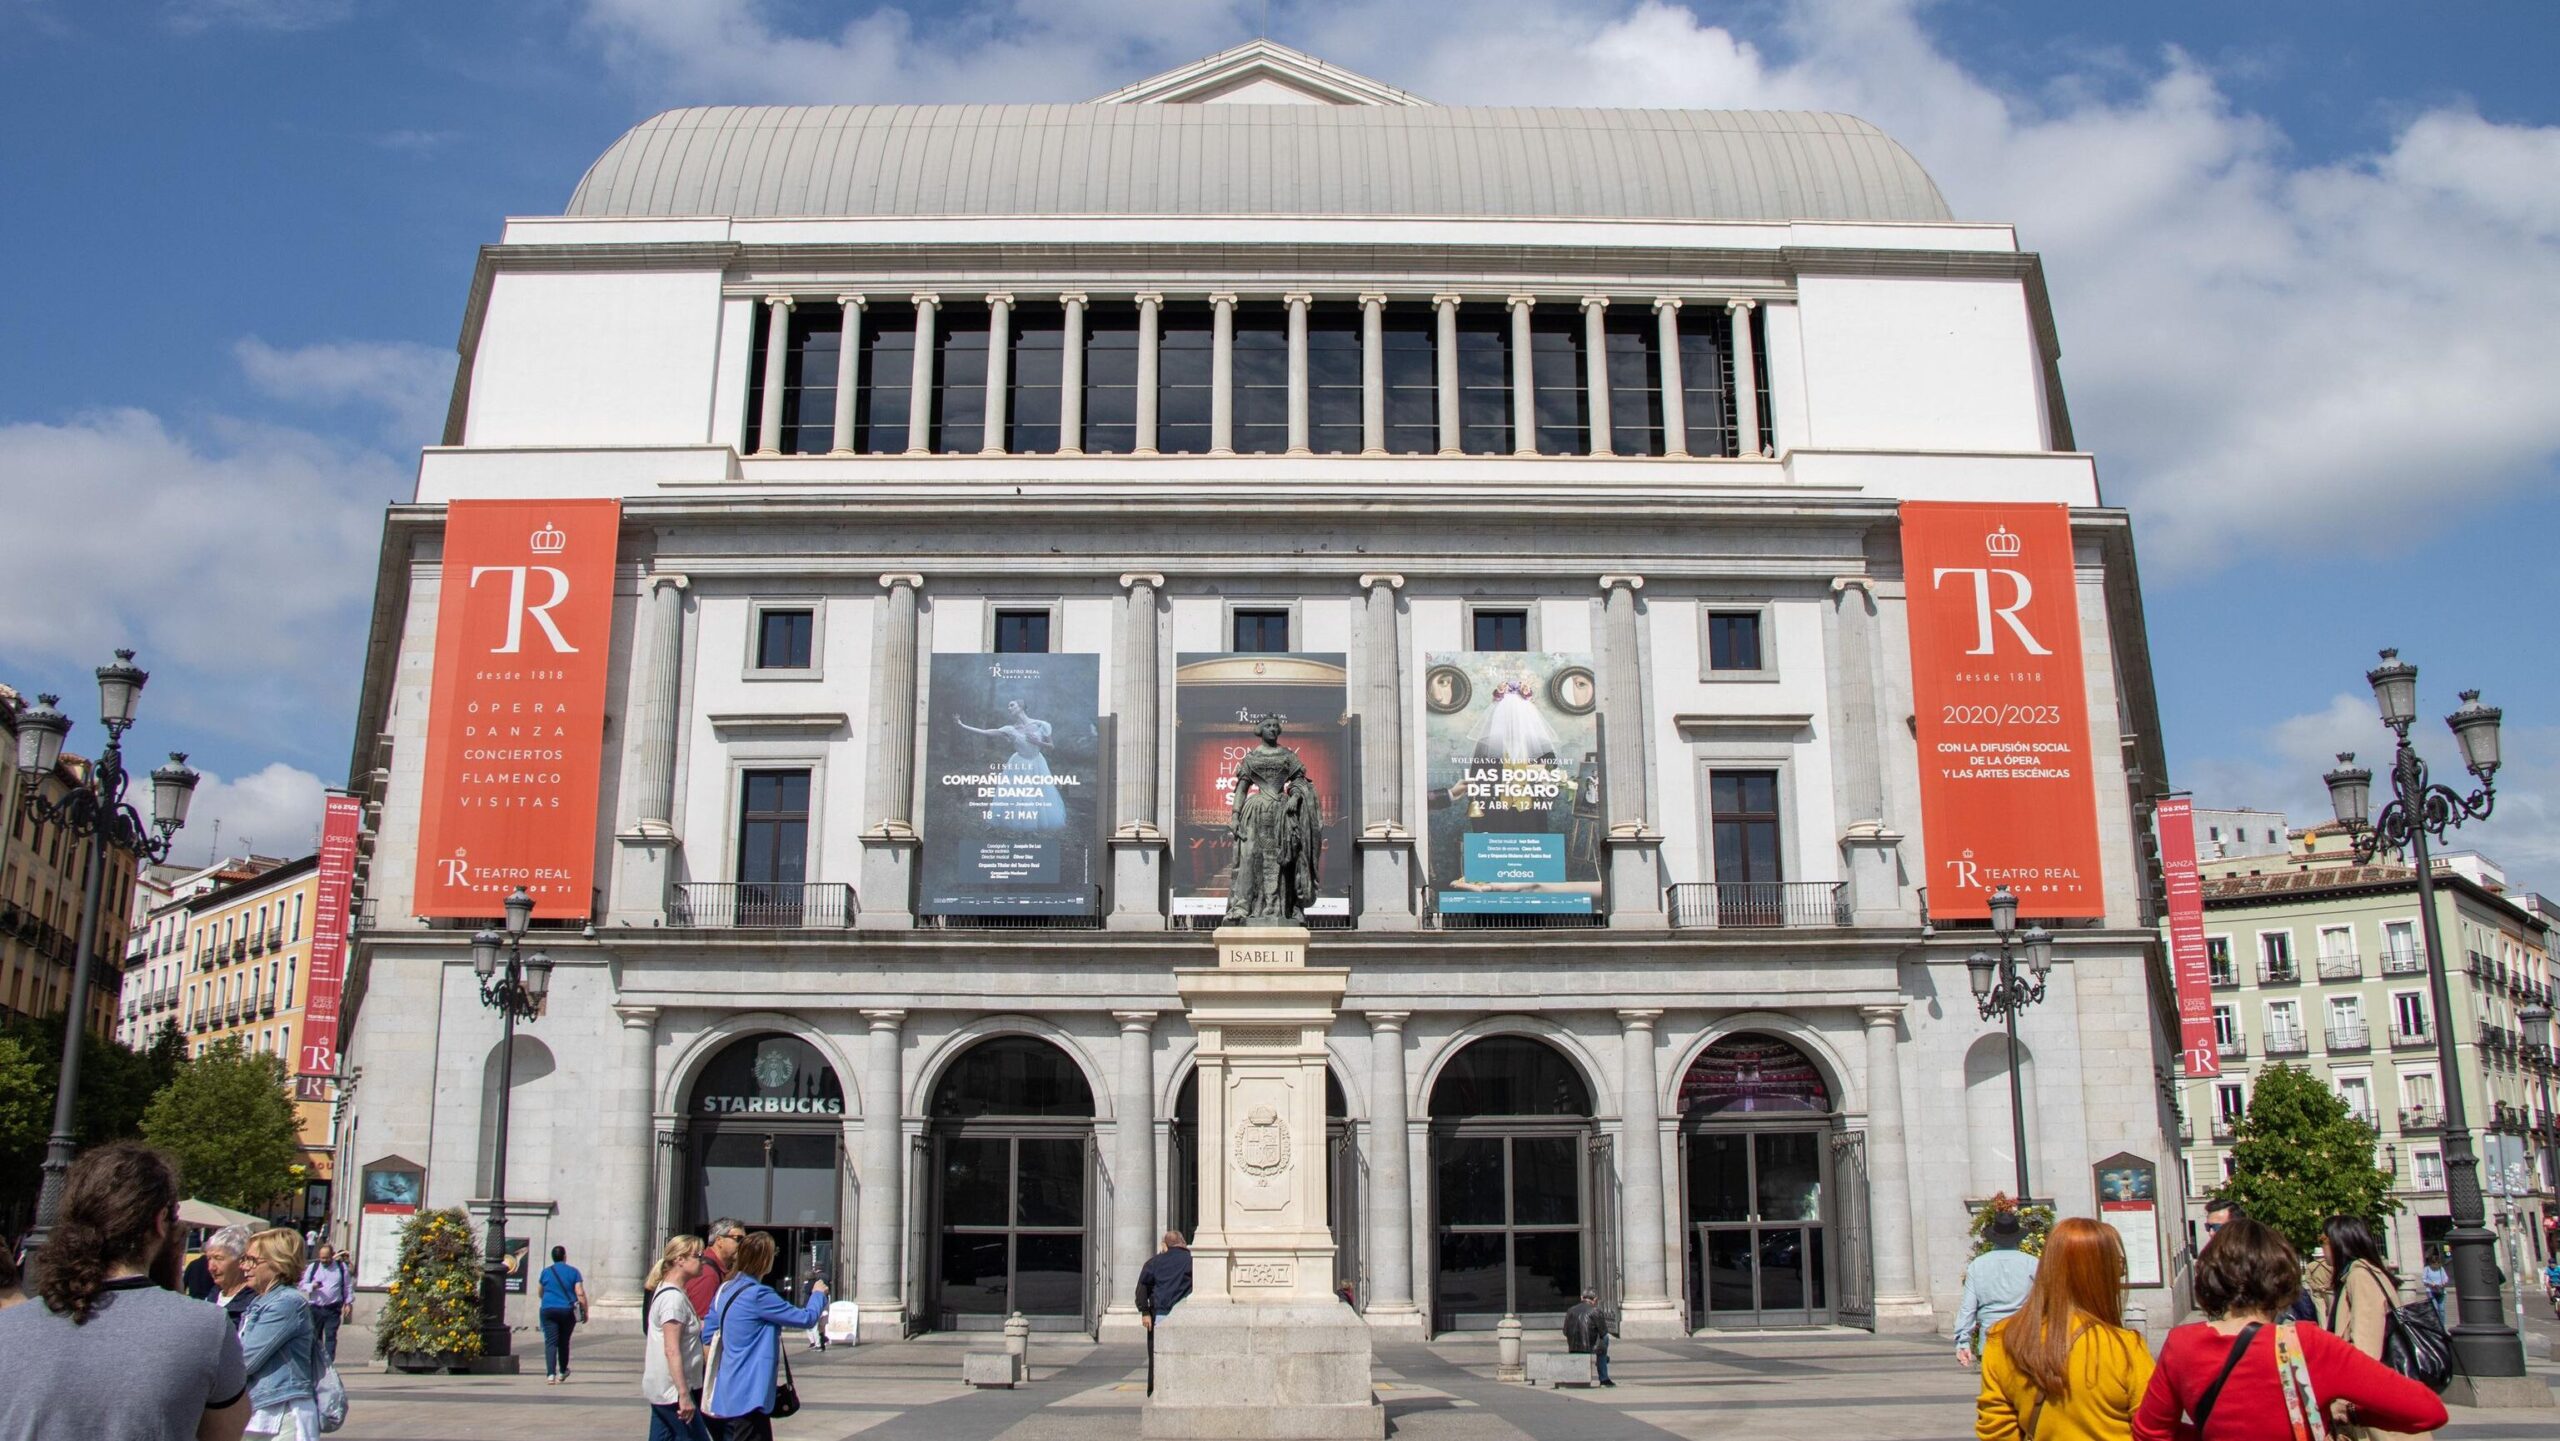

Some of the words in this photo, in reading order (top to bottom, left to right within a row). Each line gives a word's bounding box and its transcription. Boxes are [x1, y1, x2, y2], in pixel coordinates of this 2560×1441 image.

[470, 566, 580, 654] TR
[1933, 568, 2053, 655] TR
[476, 671, 520, 680] desde
[531, 670, 564, 680] 1818
[1956, 672, 2000, 682] desde
[2010, 672, 2042, 682] 1818
[468, 701, 566, 713] ÓPERA
[1943, 704, 2061, 726] 2020/2023
[466, 726, 564, 736] DANZA
[1937, 743, 1961, 752] CON
[1964, 743, 1978, 752] LA
[1980, 741, 2031, 752] DIFUSIÓN
[2032, 743, 2071, 752] SOCIAL
[464, 750, 563, 760] CONCIERTOS
[1970, 756, 1985, 765] DE
[1987, 757, 2001, 765] LA
[2003, 754, 2041, 765] ÓPERA
[1464, 768, 1498, 781] LAS
[1502, 769, 1562, 782] BODAS
[1942, 769, 1951, 778] Y
[1952, 769, 1974, 778] LAS
[1975, 769, 2010, 778] ARTES
[2011, 767, 2071, 778] ESCÉNICAS
[462, 773, 561, 784] FLAMENCO
[942, 772, 1010, 785] COMPAÑÍA
[1013, 775, 1080, 785] NACIONAL
[977, 787, 996, 798] DE
[998, 787, 1043, 798] DANZA
[1467, 784, 1491, 797] DE
[1495, 781, 1559, 797] FÍGARO
[460, 797, 560, 807] VISITAS
[1473, 801, 1485, 810] 22
[1489, 801, 1509, 810] ABR
[1519, 801, 1531, 810] 12
[1533, 801, 1554, 810] MAY
[982, 811, 993, 819] 18
[1004, 811, 1014, 819] 21
[1018, 811, 1038, 819] MAY
[2166, 860, 2195, 868] DANZA
[474, 867, 529, 879] TEATRO
[535, 868, 571, 879] REAL
[1497, 869, 1534, 878] endesa
[1984, 868, 2039, 879] TEATRO
[2044, 868, 2080, 879] REAL
[1231, 950, 1279, 963] ISABEL
[1285, 951, 1294, 963] II
[703, 1095, 841, 1114] STARBUCKS
